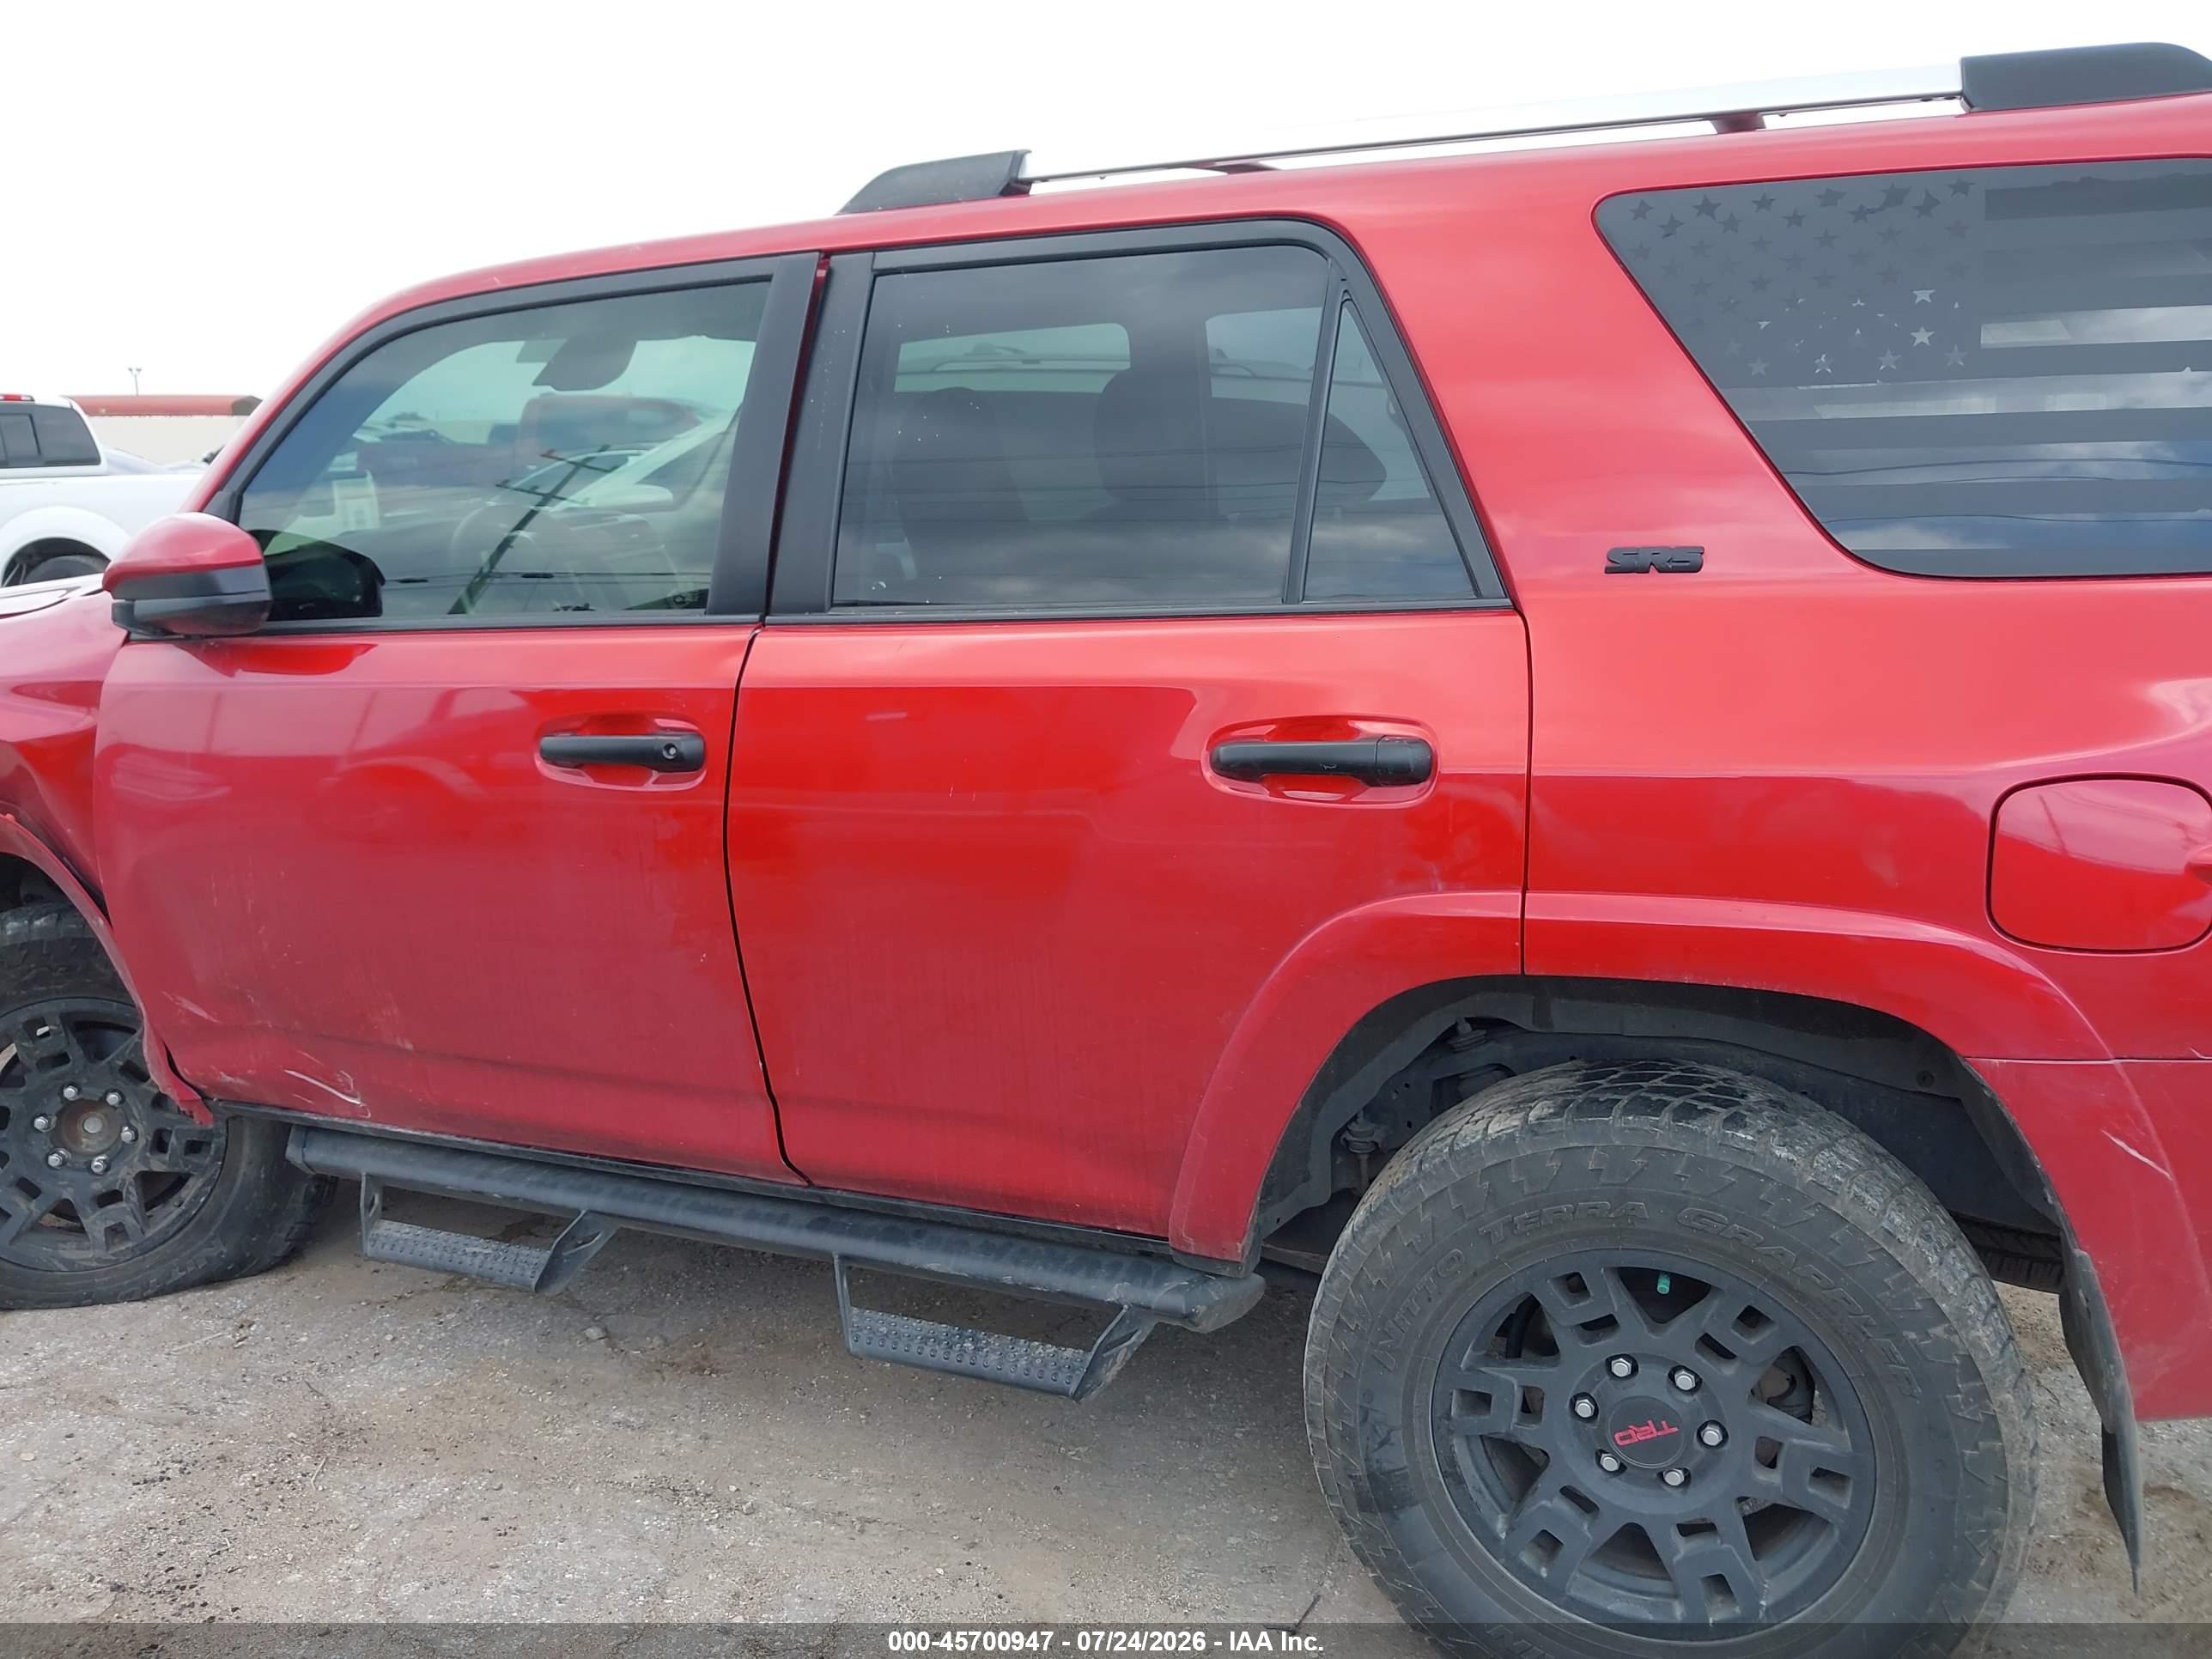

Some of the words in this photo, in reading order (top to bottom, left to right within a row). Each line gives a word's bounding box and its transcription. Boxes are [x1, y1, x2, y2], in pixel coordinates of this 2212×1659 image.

[1604, 546, 1705, 574] SR5
[1478, 1201, 1650, 1245] TERRA
[1614, 1419, 1679, 1446] TRD
